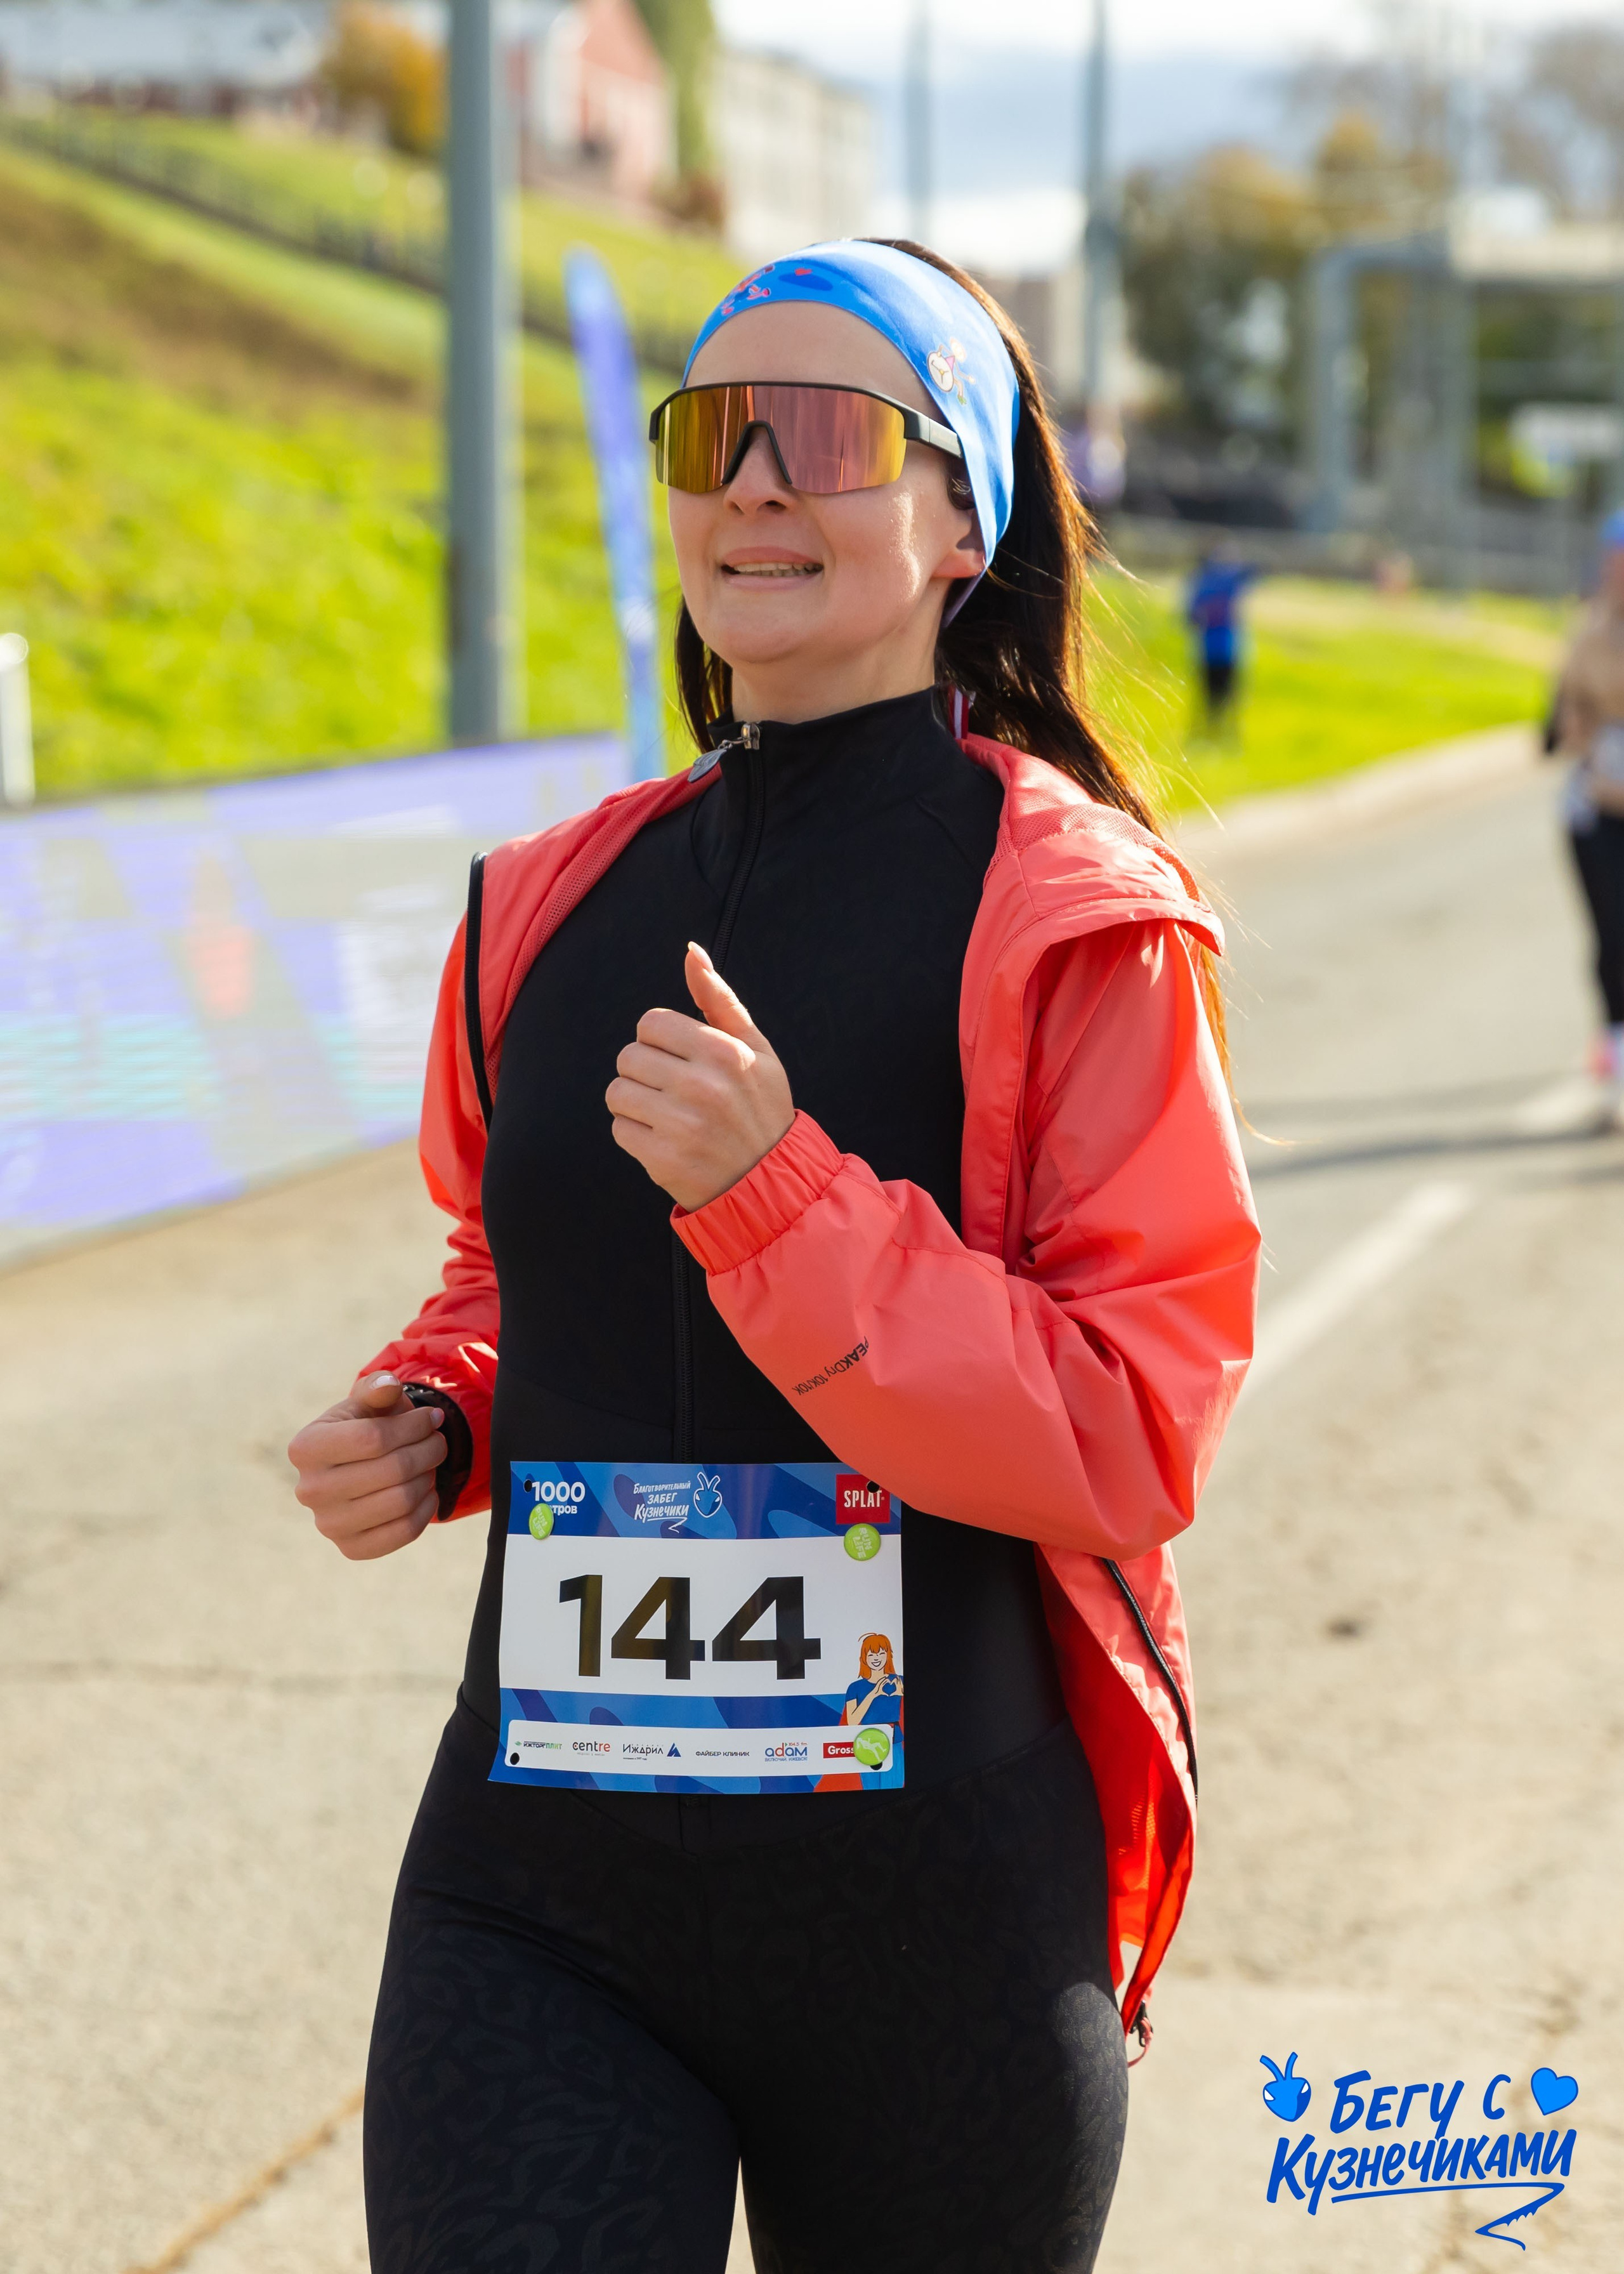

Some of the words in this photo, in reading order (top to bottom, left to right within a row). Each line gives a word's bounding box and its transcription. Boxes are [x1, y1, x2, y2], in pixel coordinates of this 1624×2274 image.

[824, 1336, 869, 1377] PEAKDry
[532, 1481, 586, 1502] 1000
[647, 1492, 678, 1504] ЗАБЕГ
[844, 1490, 882, 1508] SPLAT
[634, 1503, 690, 1523] Кузнечики
[852, 1536, 867, 1558] LIFE
[859, 1527, 873, 1550] RUN
[559, 1574, 822, 1680] 144
[572, 1740, 611, 1752] centre
